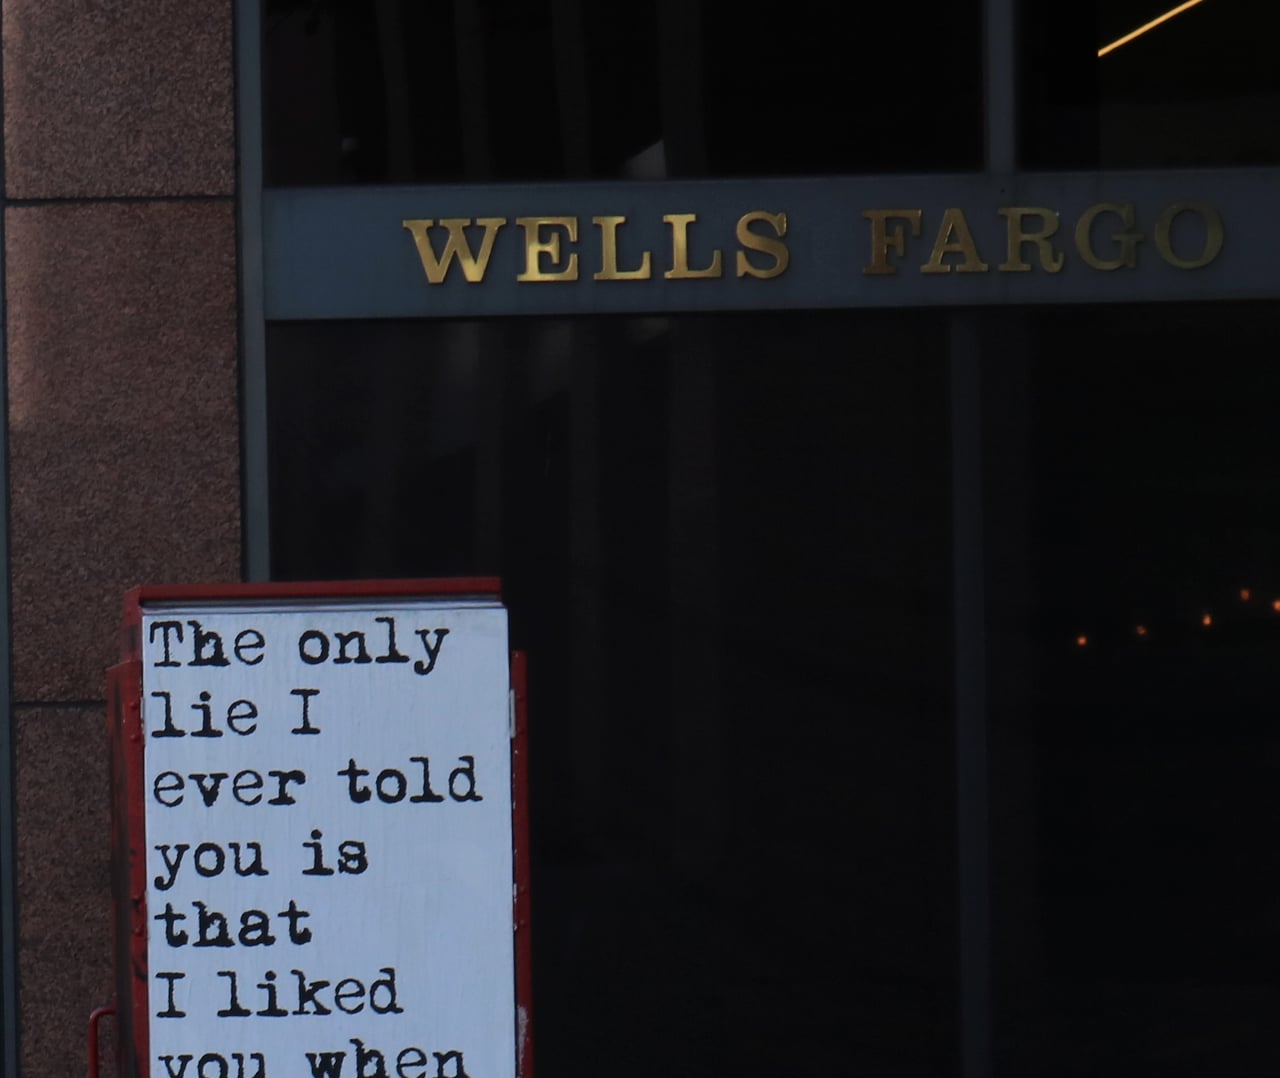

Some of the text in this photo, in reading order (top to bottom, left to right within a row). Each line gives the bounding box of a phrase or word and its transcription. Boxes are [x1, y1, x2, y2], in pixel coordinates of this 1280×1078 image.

[401, 202, 1225, 284] WELLS FARGO
[149, 616, 450, 676] The only
[150, 688, 321, 739] lie I
[153, 755, 484, 808] ever told
[153, 828, 370, 892] you is
[153, 899, 313, 949] that
[155, 967, 404, 1019] I liked
